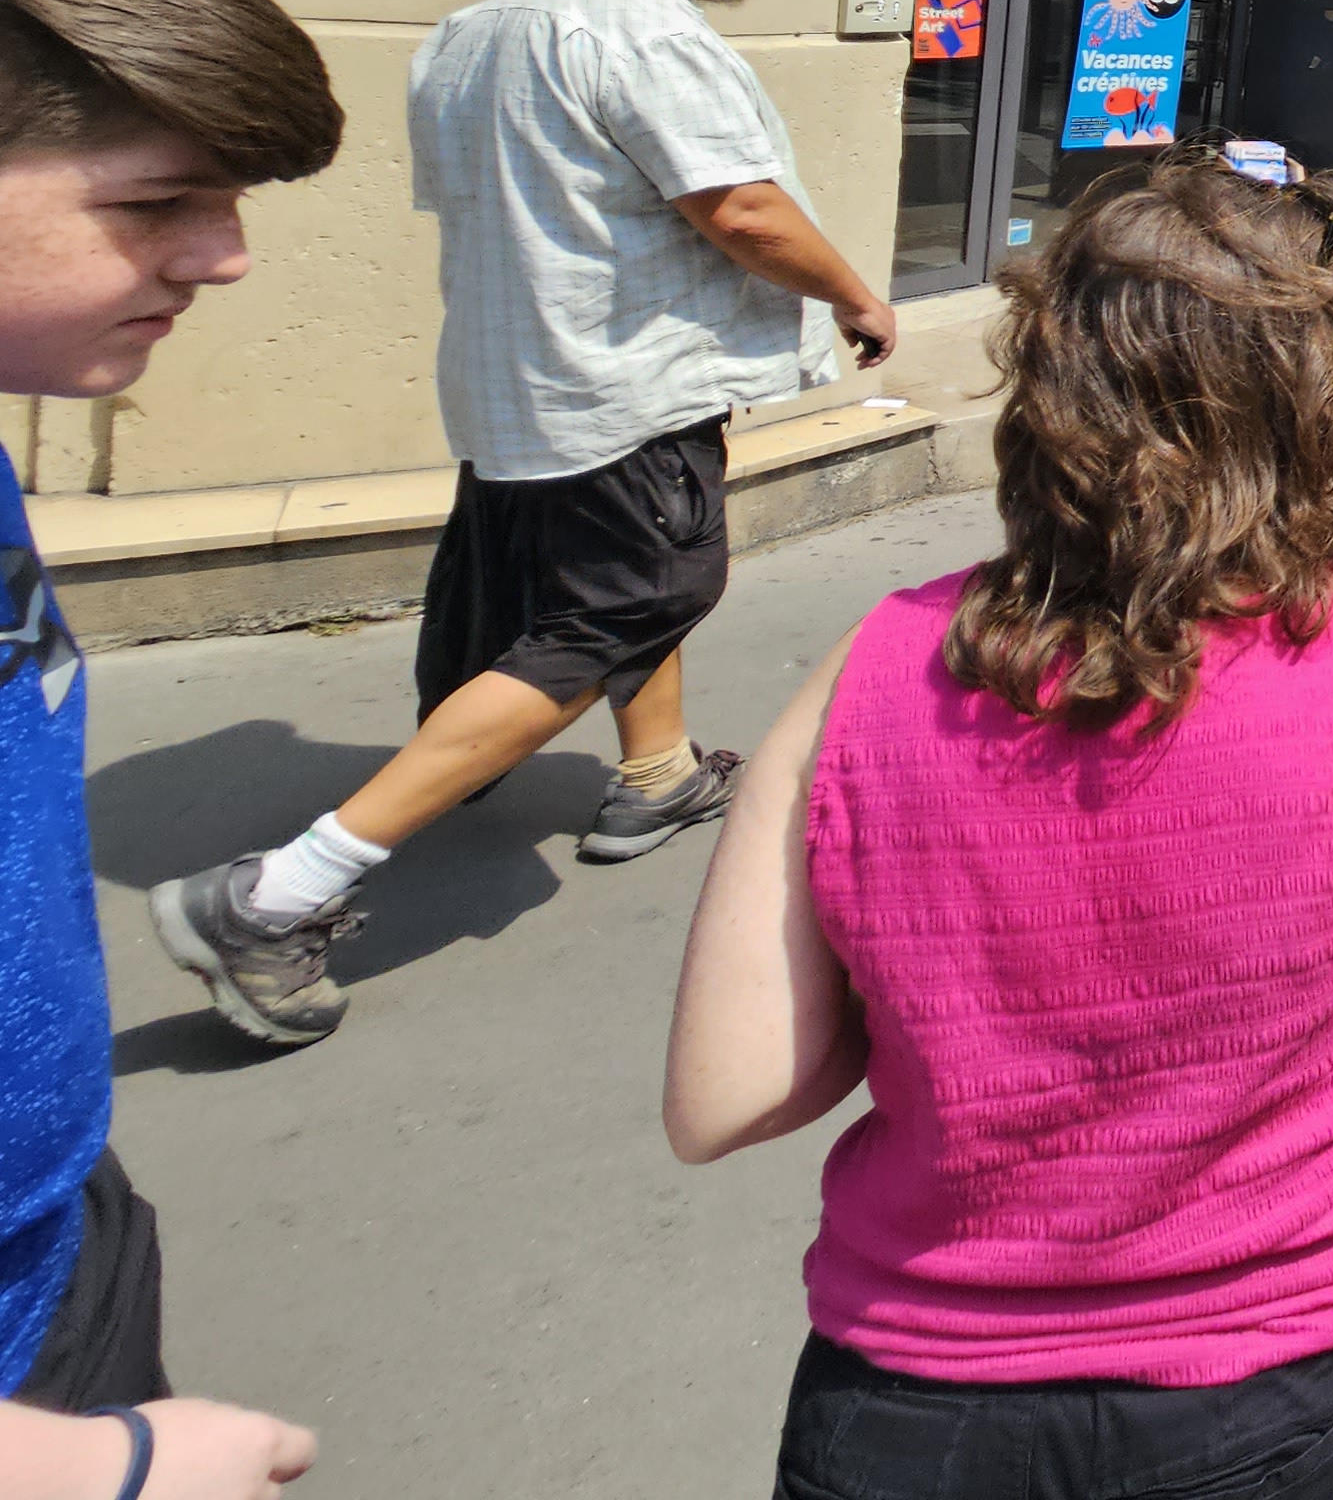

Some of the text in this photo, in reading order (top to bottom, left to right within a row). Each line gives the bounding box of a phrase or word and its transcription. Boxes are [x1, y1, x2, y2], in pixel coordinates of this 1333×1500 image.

[918, 6, 964, 19] Street
[918, 20, 945, 33] Art
[1081, 50, 1174, 70] Vacances
[1077, 72, 1169, 93] créatives
